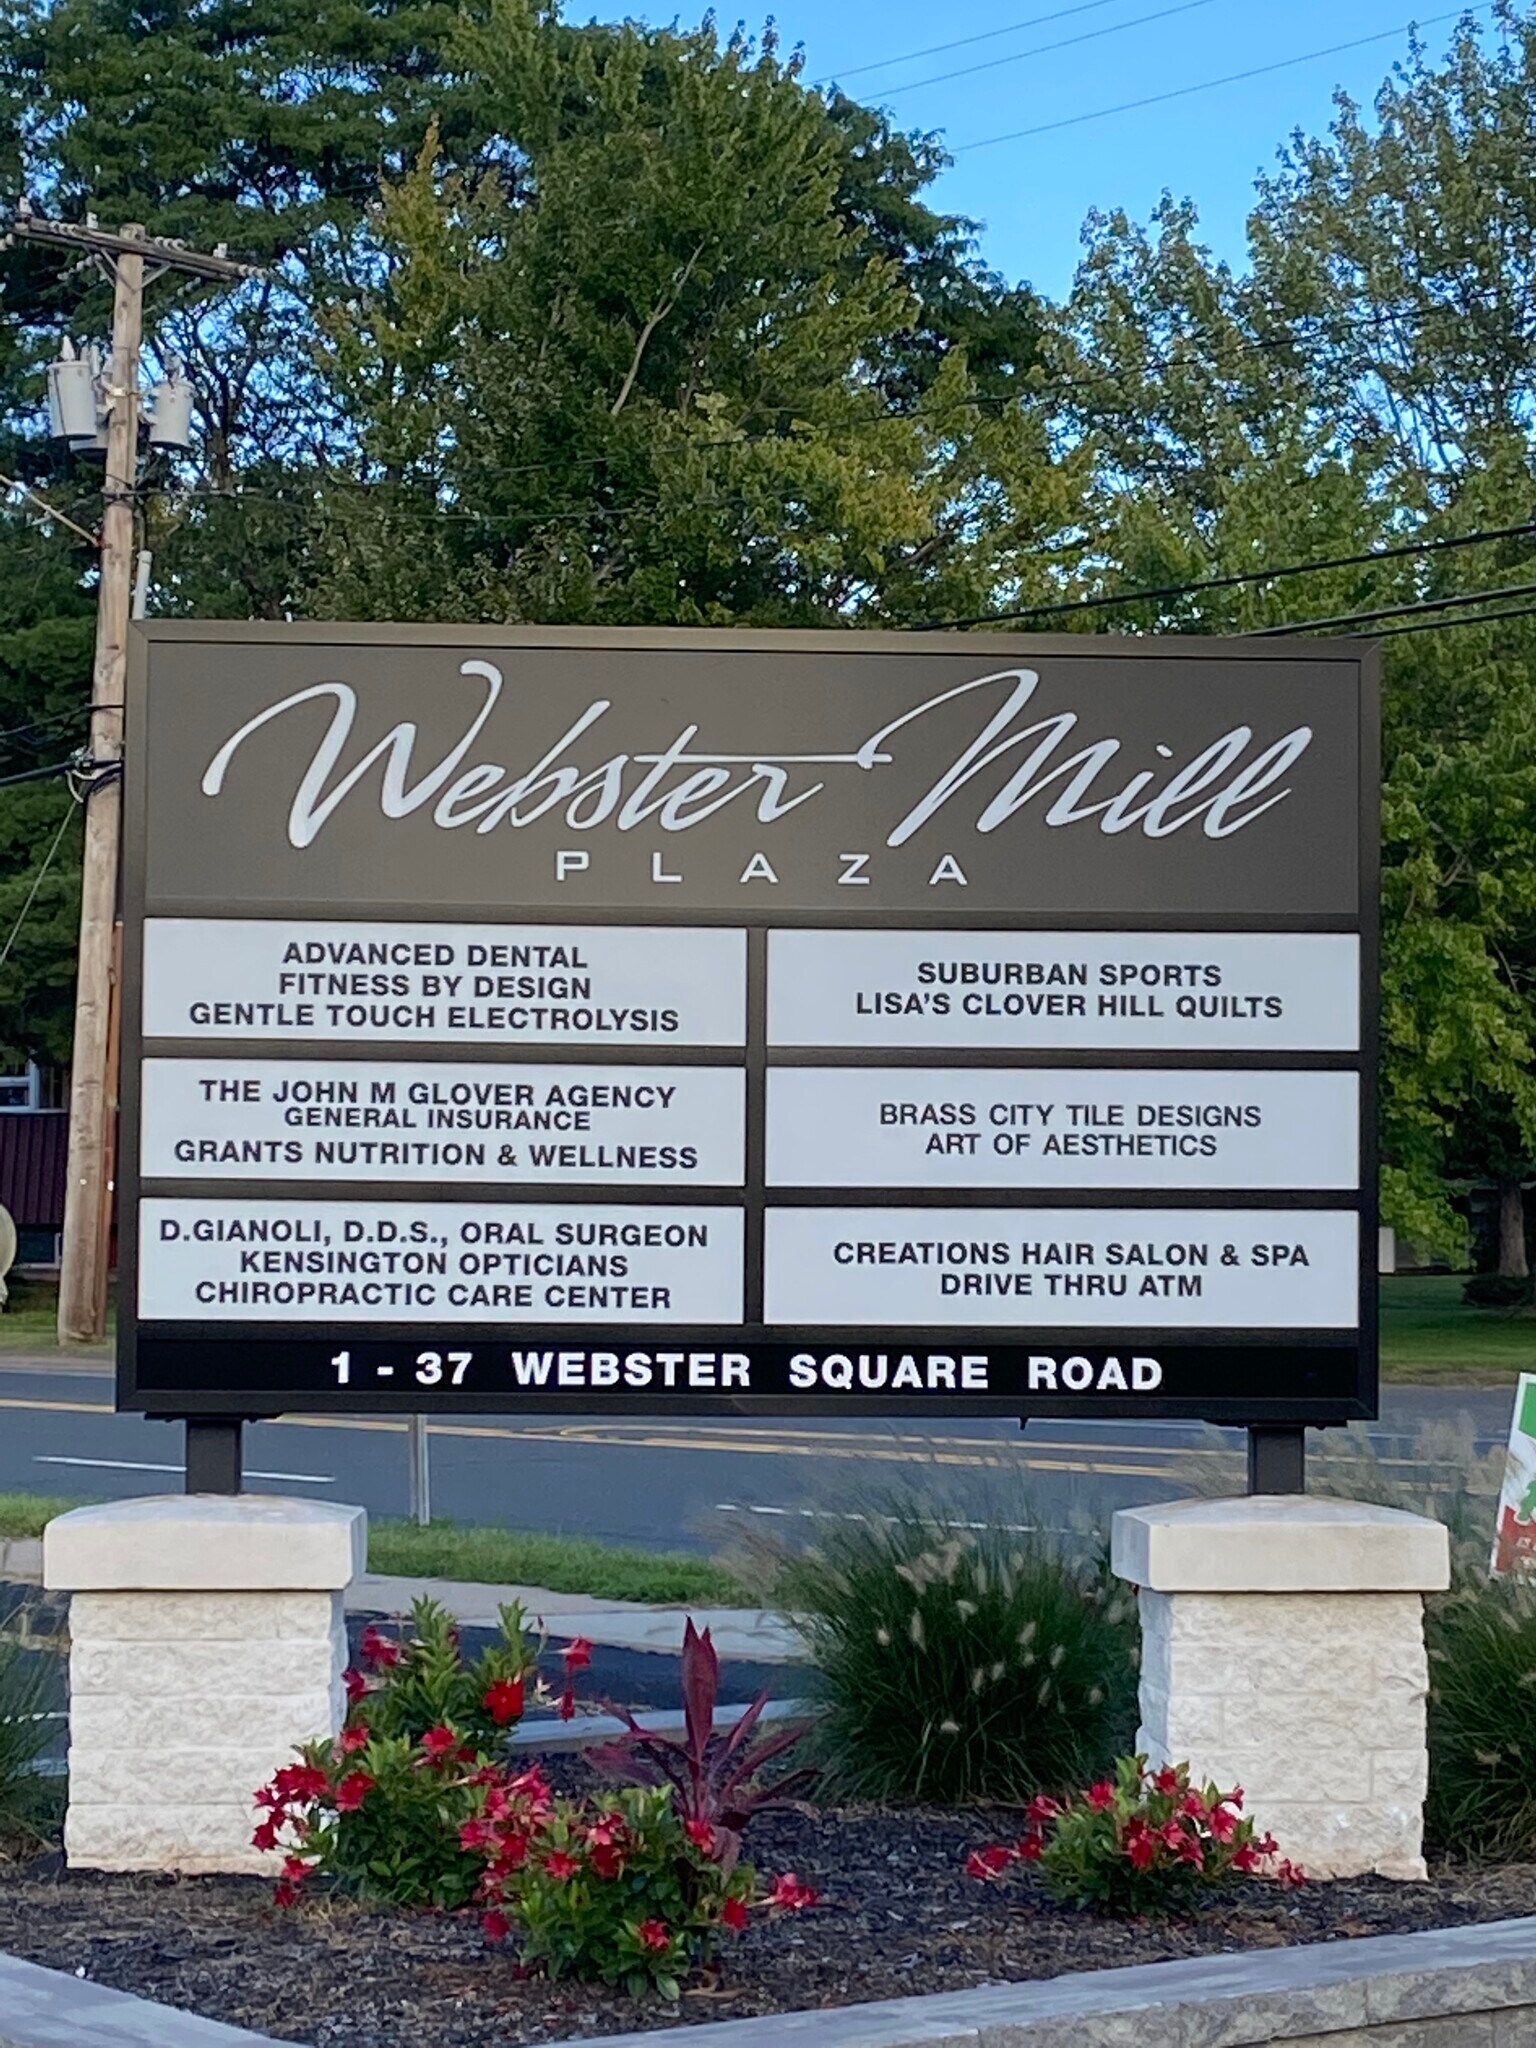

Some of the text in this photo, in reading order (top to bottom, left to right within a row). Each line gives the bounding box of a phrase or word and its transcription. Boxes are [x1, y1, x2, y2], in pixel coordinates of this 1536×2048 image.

[202, 660, 1313, 848] Webster Mill
[556, 850, 968, 886] PLAZA
[282, 941, 588, 969] ADVANCED DENTAL
[279, 972, 591, 1000] FITNESS BY DESIGN
[917, 962, 1222, 987] SUBURBAN SPORTS
[189, 1002, 679, 1032] GENTLE TOUCH ELECTROLYSIS
[856, 992, 1283, 1019] LISA'S CLOVER HILL QUILTS
[198, 1079, 676, 1109] THE JOHN M GLOVER AGENCY
[284, 1106, 591, 1131] GENERAL INSURANCE
[880, 1102, 1262, 1128] BRASS CITY TILE DESIGNS
[174, 1139, 698, 1169] GRANTS NUTRITION & WELLNESS
[925, 1133, 1218, 1157] ART OF AESTHETICS
[460, 1221, 544, 1245] ORAL
[555, 1223, 708, 1247] SURGEON
[240, 1250, 628, 1278] KENSINGTON OPTICIANS
[833, 1242, 1310, 1267] CREATIONS HAIR SALON & SPA
[195, 1281, 671, 1309] CHIROPRACTIC CARE CENTER
[941, 1273, 1202, 1297] DRIVE THRU ATM
[331, 1351, 351, 1384] 1
[414, 1351, 474, 1386] 37
[511, 1351, 751, 1388] WEBSTER
[788, 1353, 990, 1391] SQUARE
[1026, 1355, 1164, 1391] ROAD
